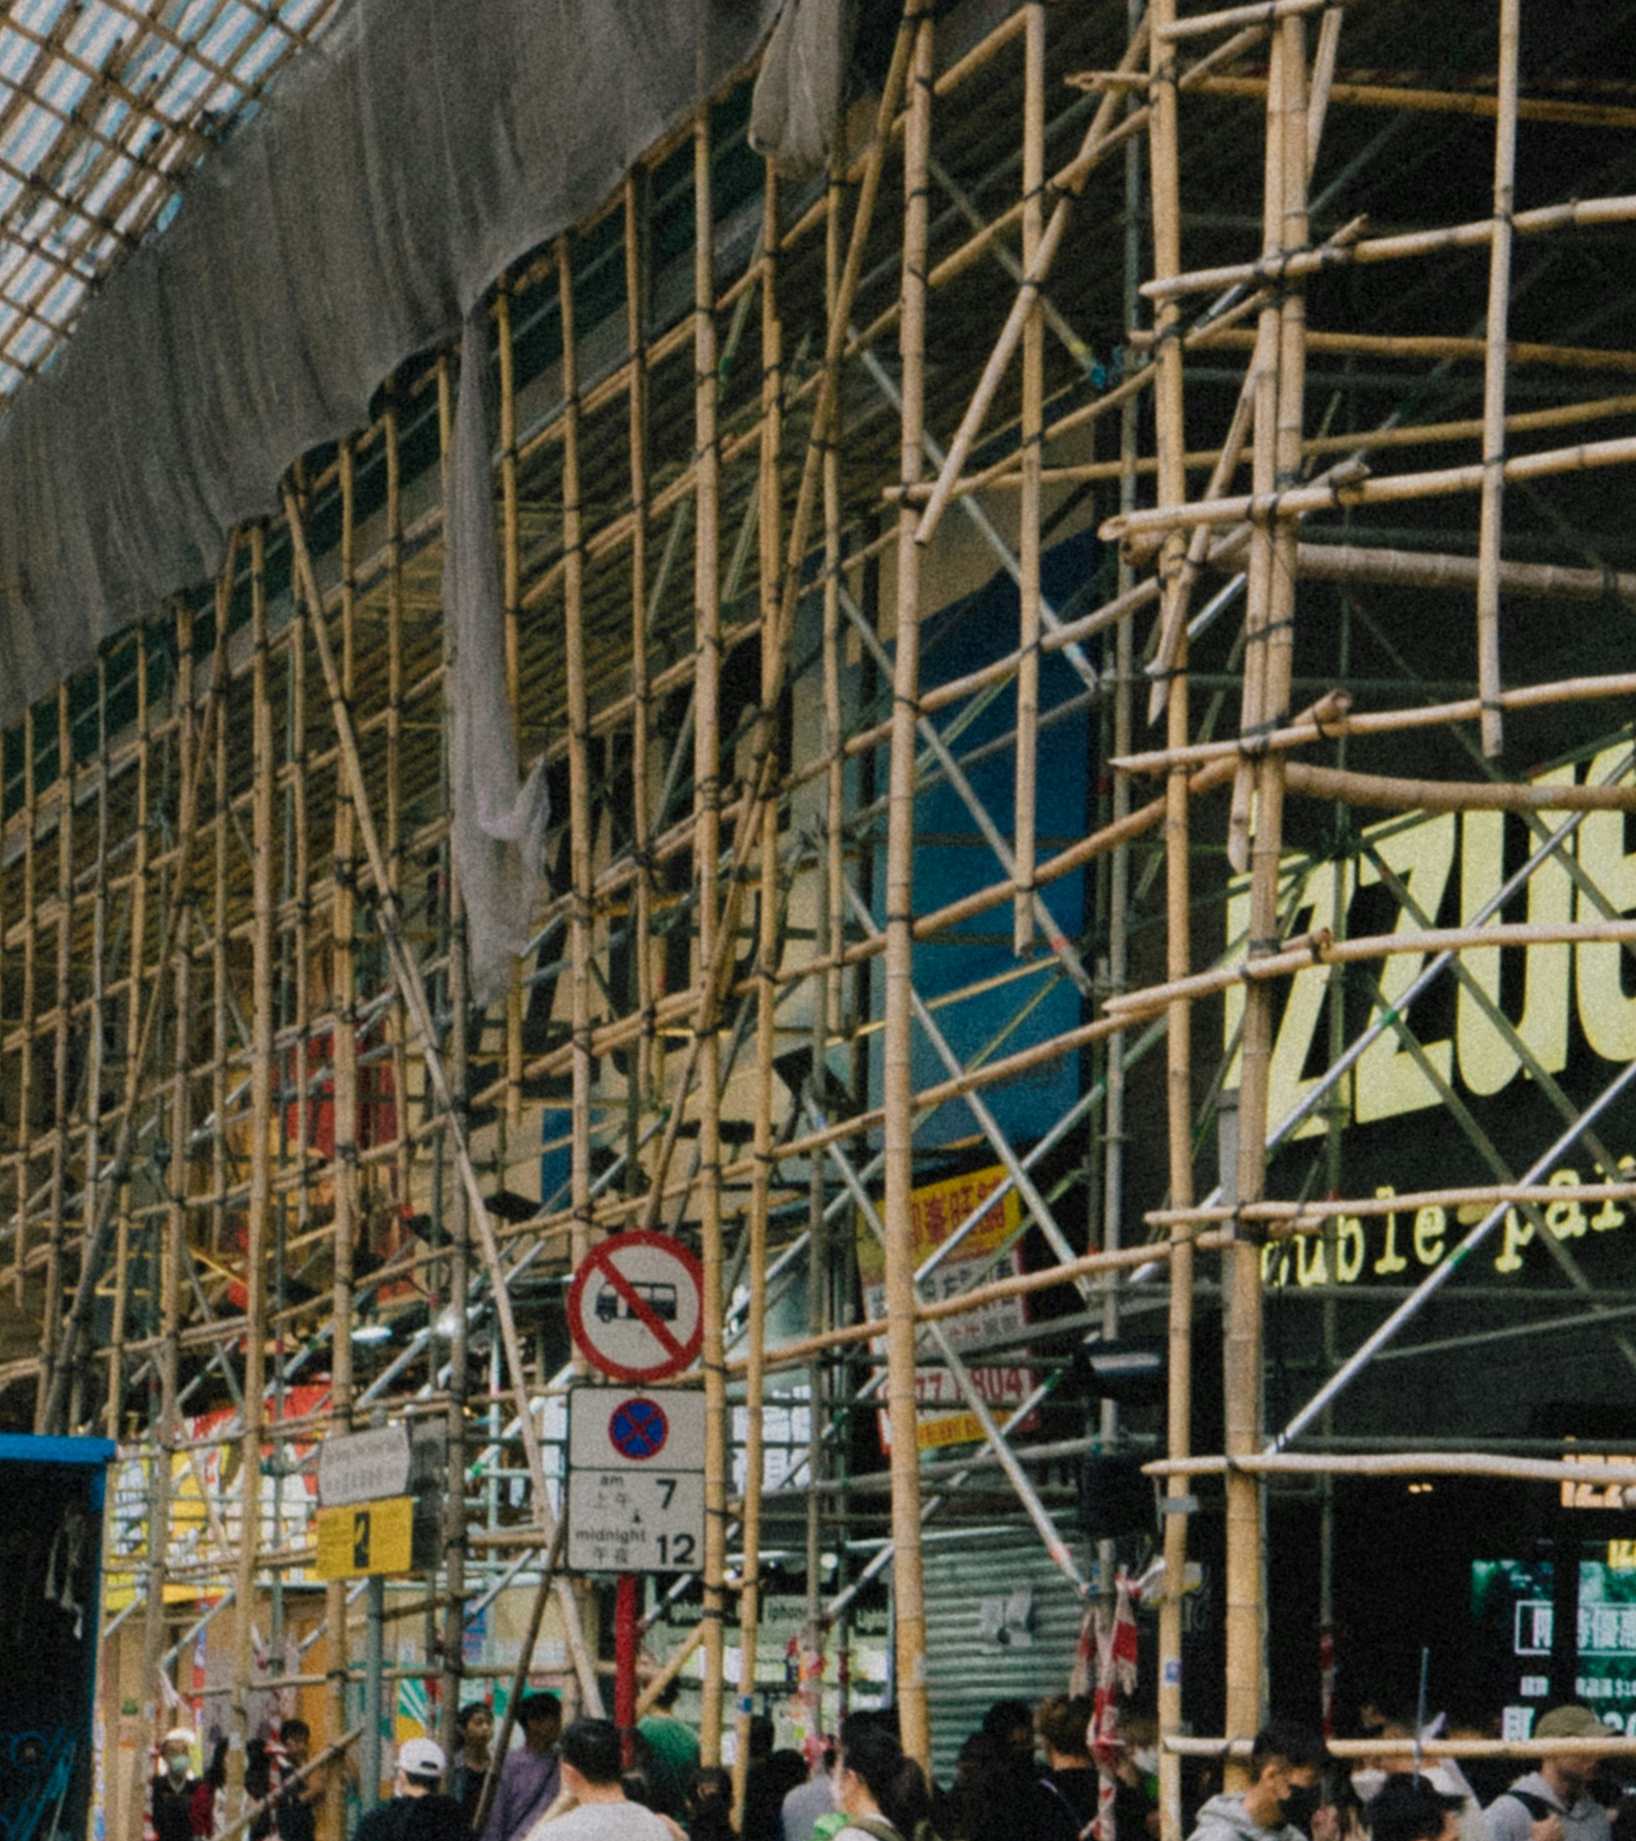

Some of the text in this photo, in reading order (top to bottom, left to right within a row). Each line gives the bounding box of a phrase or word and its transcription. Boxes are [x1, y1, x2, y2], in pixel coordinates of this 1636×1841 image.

[599, 1475, 677, 1510] am 7
[575, 1526, 696, 1565] midnight 12
